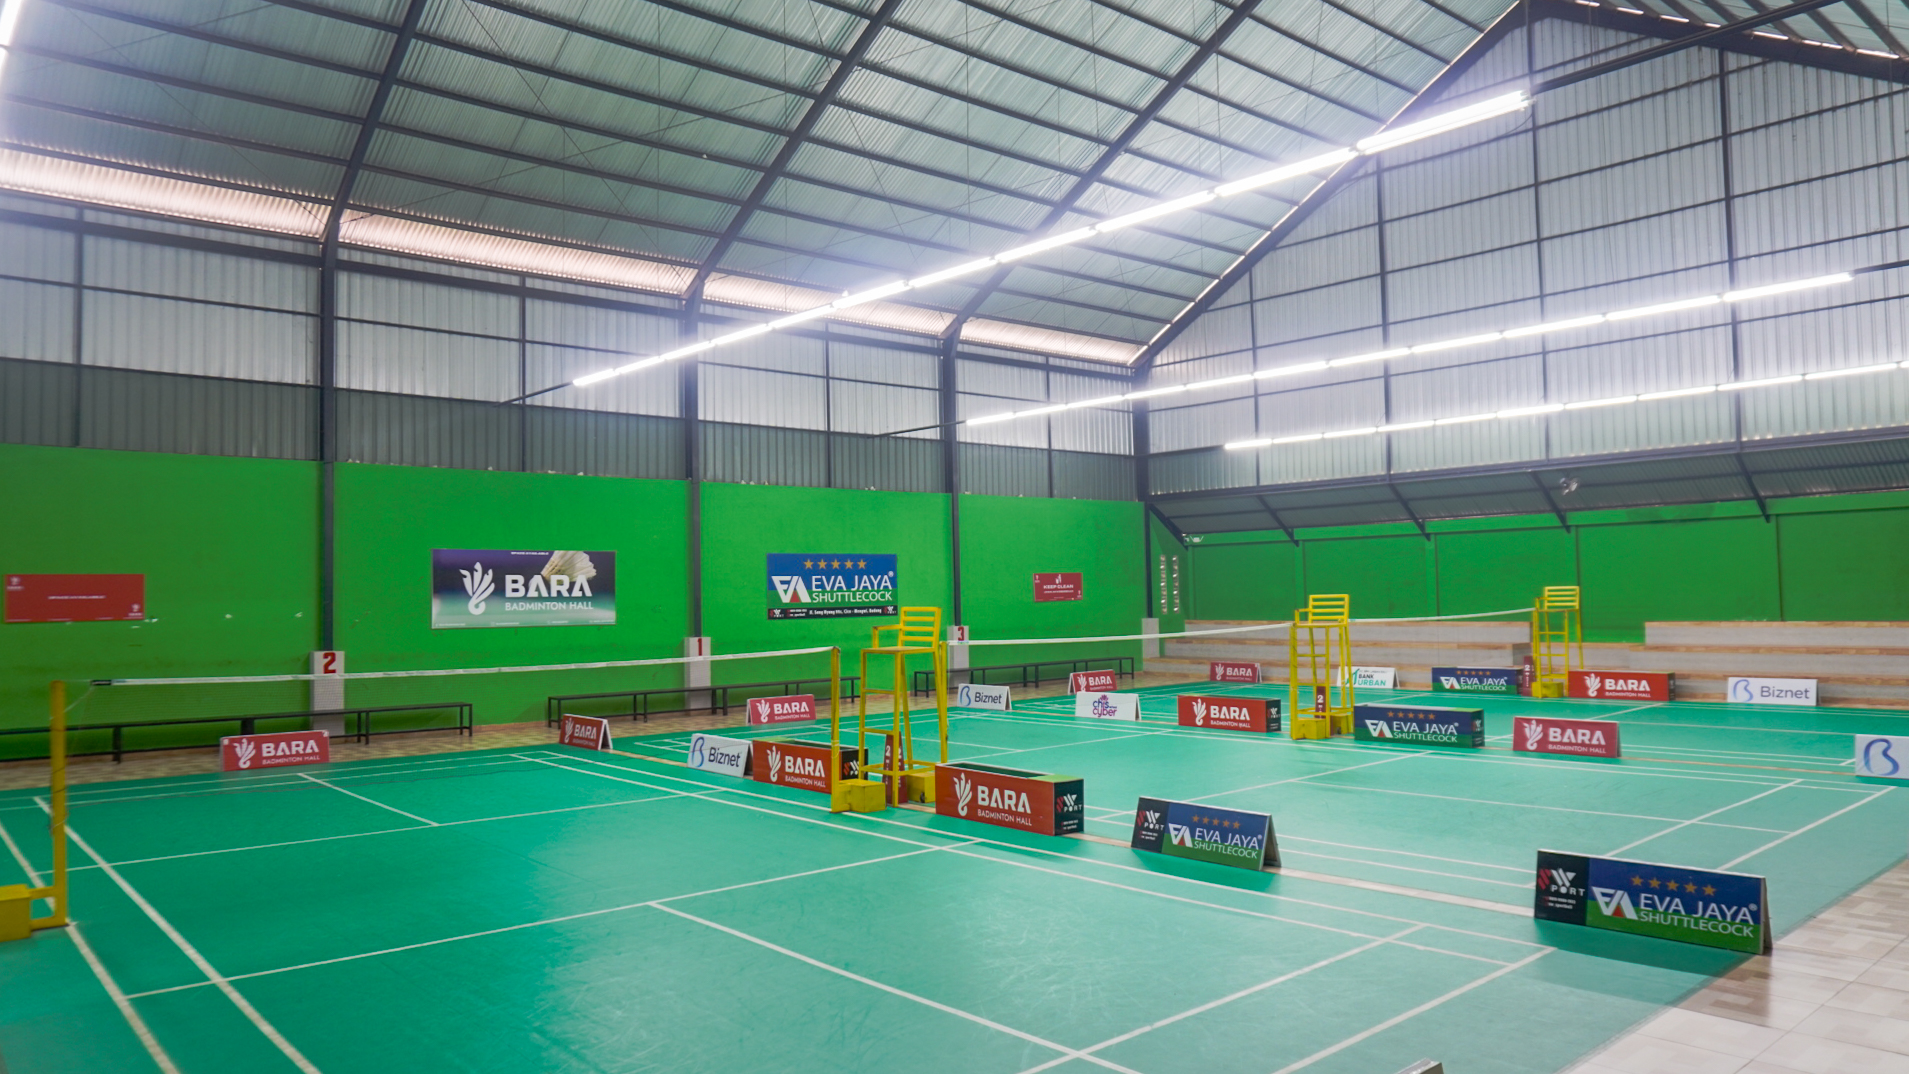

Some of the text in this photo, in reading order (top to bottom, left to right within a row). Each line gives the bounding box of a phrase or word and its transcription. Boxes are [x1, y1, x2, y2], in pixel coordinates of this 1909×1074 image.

[505, 574, 593, 598] BARA
[811, 575, 893, 591] EVA JAYA
[812, 591, 893, 603] SHUTTLECOCK
[505, 601, 594, 611] BADMINTON HALL
[957, 626, 965, 641] 3
[697, 637, 703, 656] 1
[323, 651, 337, 674] 2
[1226, 666, 1253, 677] BARA
[1088, 675, 1113, 686] BARA
[1357, 679, 1387, 687] URBAN
[1460, 676, 1480, 685] EVA
[1604, 678, 1651, 692] BARA
[974, 691, 1002, 704] Biznet
[1317, 694, 1324, 703] 2
[1760, 685, 1810, 700] Biznet
[773, 701, 810, 715] BARA
[1092, 707, 1117, 718] cyber
[1210, 705, 1251, 721] BARA
[1210, 719, 1238, 727] BADMINTON
[1393, 721, 1420, 733] EVA
[1423, 723, 1458, 736] JAYA
[574, 724, 598, 740] BARA
[1393, 731, 1458, 743] SHUTTLECOCK
[1548, 727, 1606, 746] BARA
[261, 740, 320, 757] BARA
[1548, 744, 1607, 754] BADMINTON HALL
[262, 756, 303, 765] BADMINTON
[708, 747, 741, 768] Biznet
[784, 755, 826, 778] BARA
[785, 774, 826, 788] BADMINTON HALL
[977, 785, 1032, 814] BARA
[977, 808, 1033, 827] BADMINTON HALL
[1194, 827, 1259, 851] EVA JAYA
[1193, 840, 1258, 860] SHUTTLECOCK
[1639, 892, 1755, 926] EVA JAYA
[1638, 910, 1755, 938] SHUTTLECOCK
